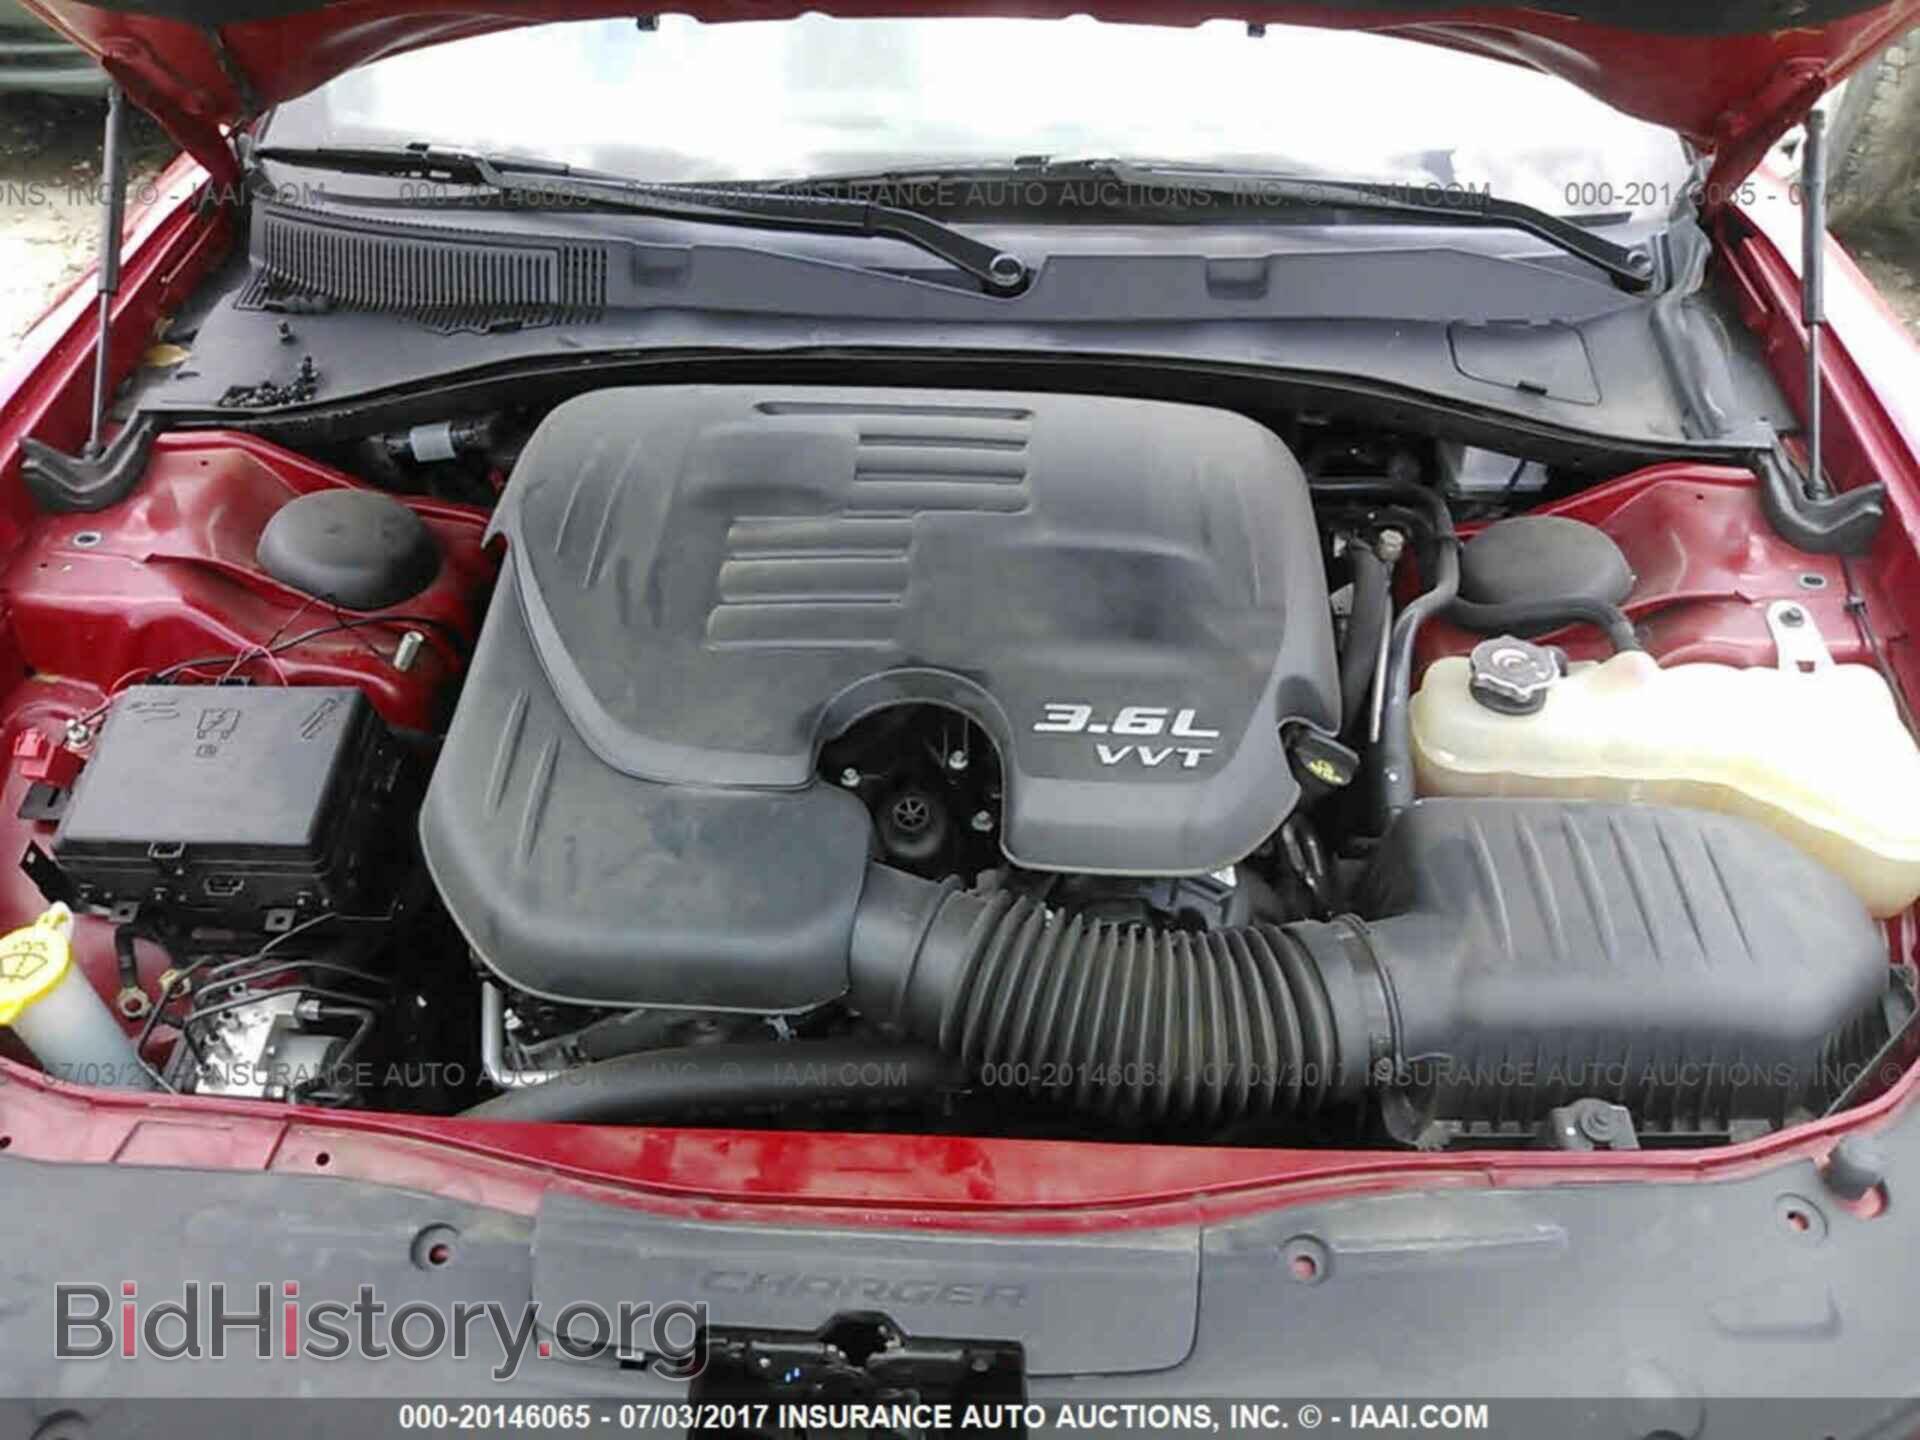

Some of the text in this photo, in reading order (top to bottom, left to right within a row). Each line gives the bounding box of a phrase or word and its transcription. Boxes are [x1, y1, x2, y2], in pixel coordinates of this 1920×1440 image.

[1033, 703, 1220, 738] 3.6L
[1096, 743, 1213, 767] VVT
[702, 1271, 1026, 1307] CHARGER
